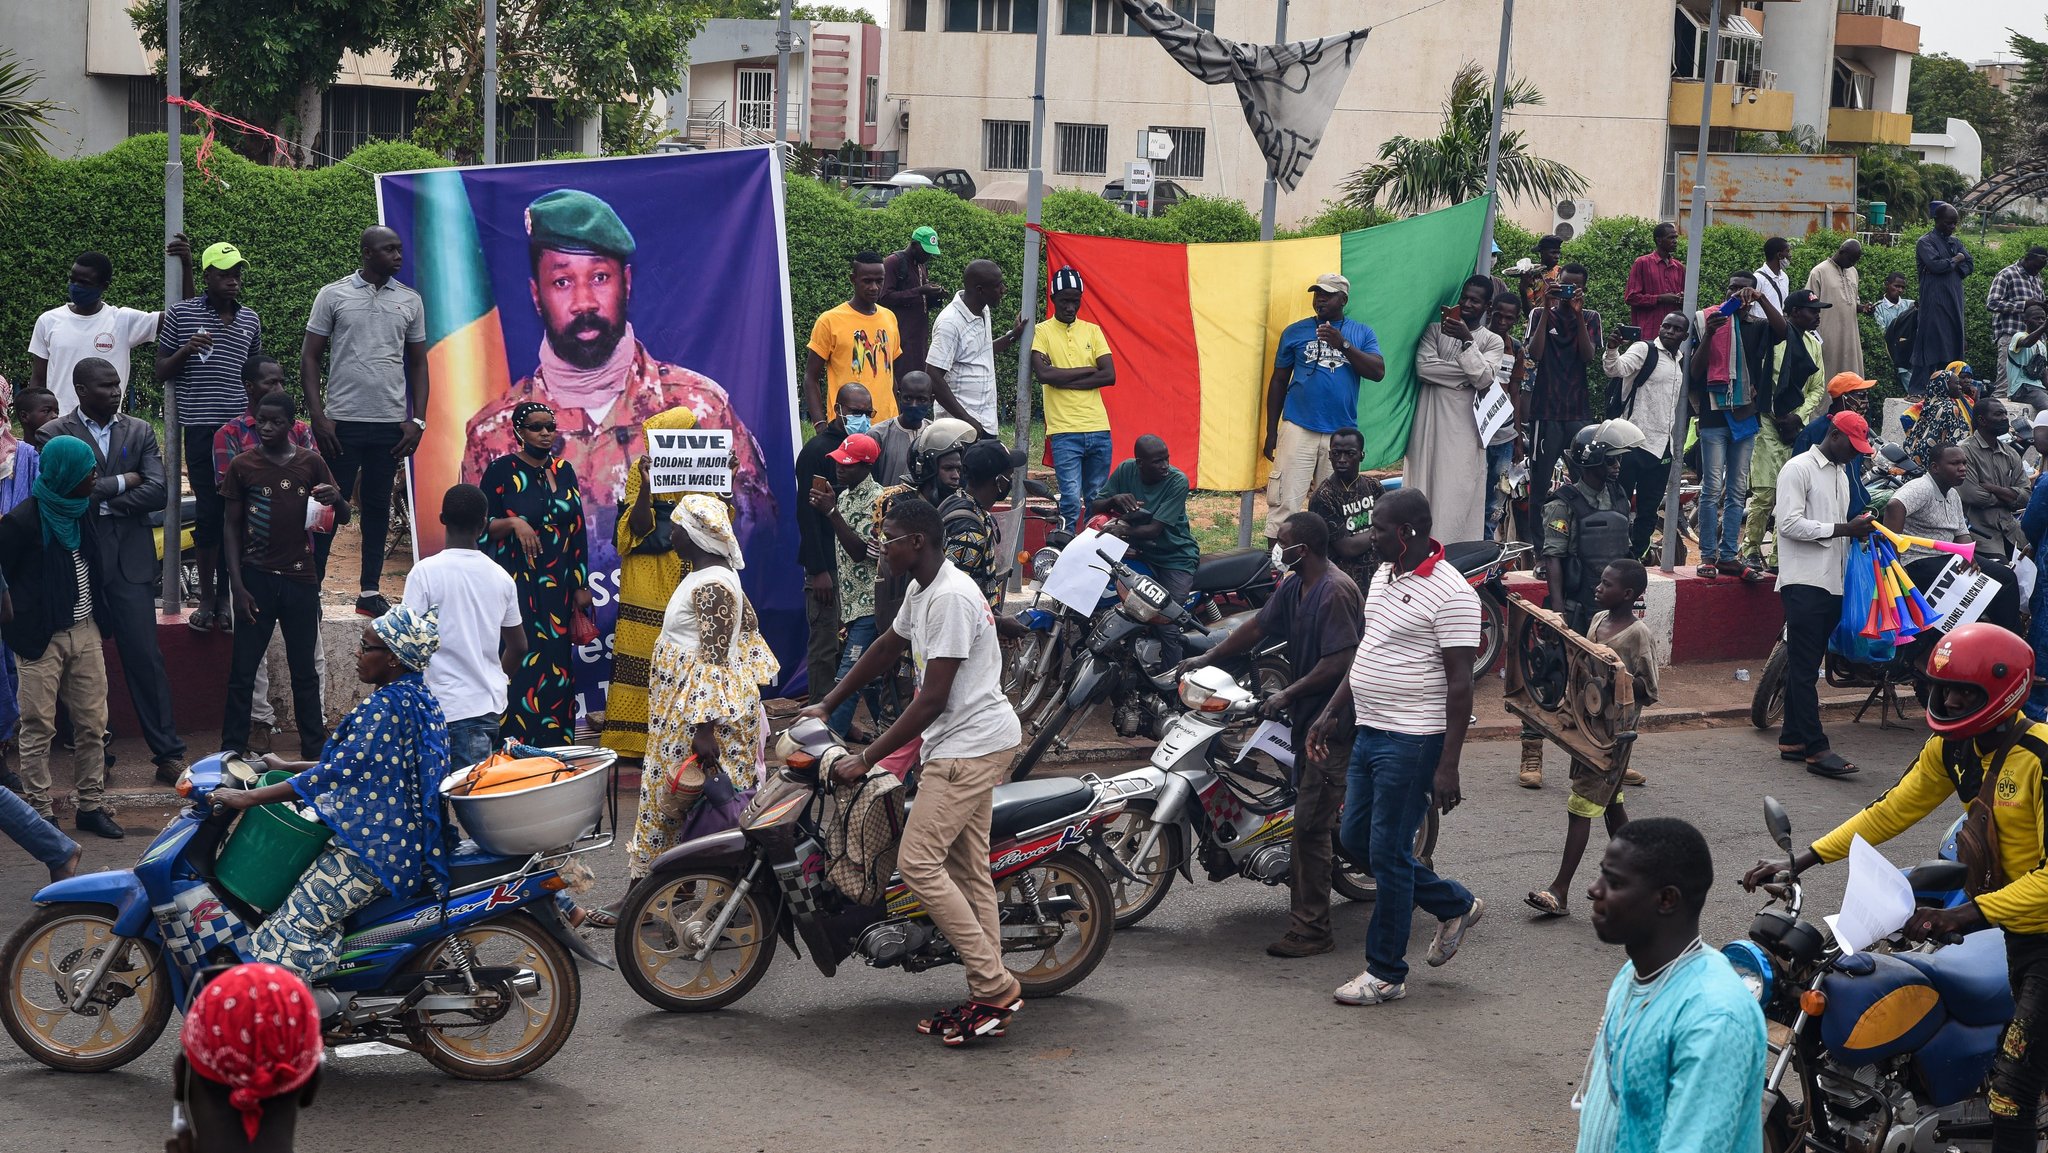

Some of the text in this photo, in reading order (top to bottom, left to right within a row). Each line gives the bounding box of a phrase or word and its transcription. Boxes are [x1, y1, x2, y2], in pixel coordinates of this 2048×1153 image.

[654, 435, 726, 449] VIVE
[653, 456, 728, 468] COLONEL MAJOR
[653, 474, 726, 486] ISMAEL WAGUE
[1941, 574, 1990, 633] COLONEL MALICK DIAW
[1999, 780, 2016, 793] BVB
